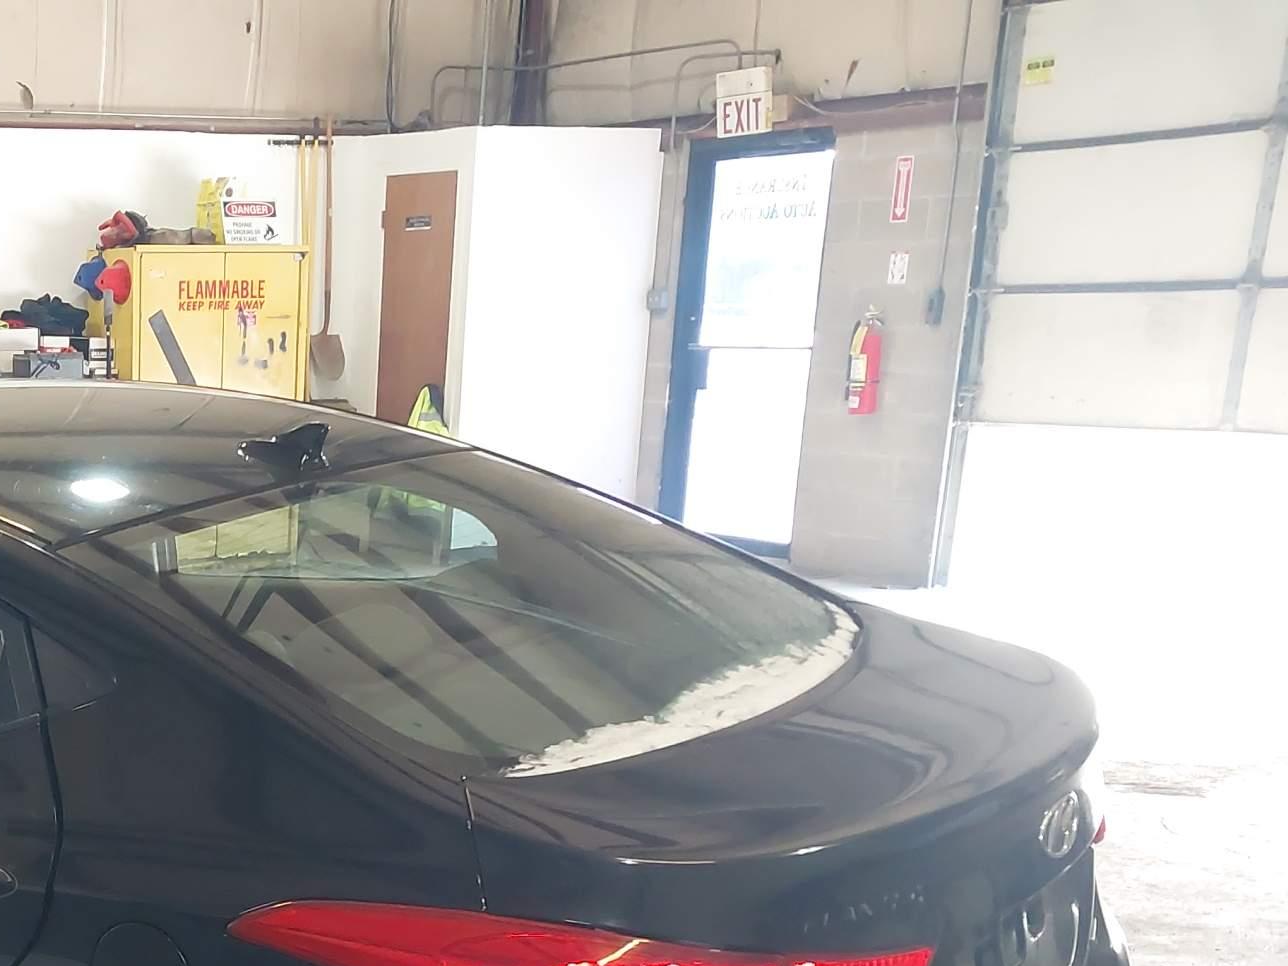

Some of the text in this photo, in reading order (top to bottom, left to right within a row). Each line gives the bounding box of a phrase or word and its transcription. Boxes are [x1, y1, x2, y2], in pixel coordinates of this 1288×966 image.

[723, 98, 761, 134] EXIT
[231, 204, 269, 215] DANGER
[178, 280, 265, 299] FLAMMABLE
[178, 300, 265, 311] KEEP FIRE AWAY
